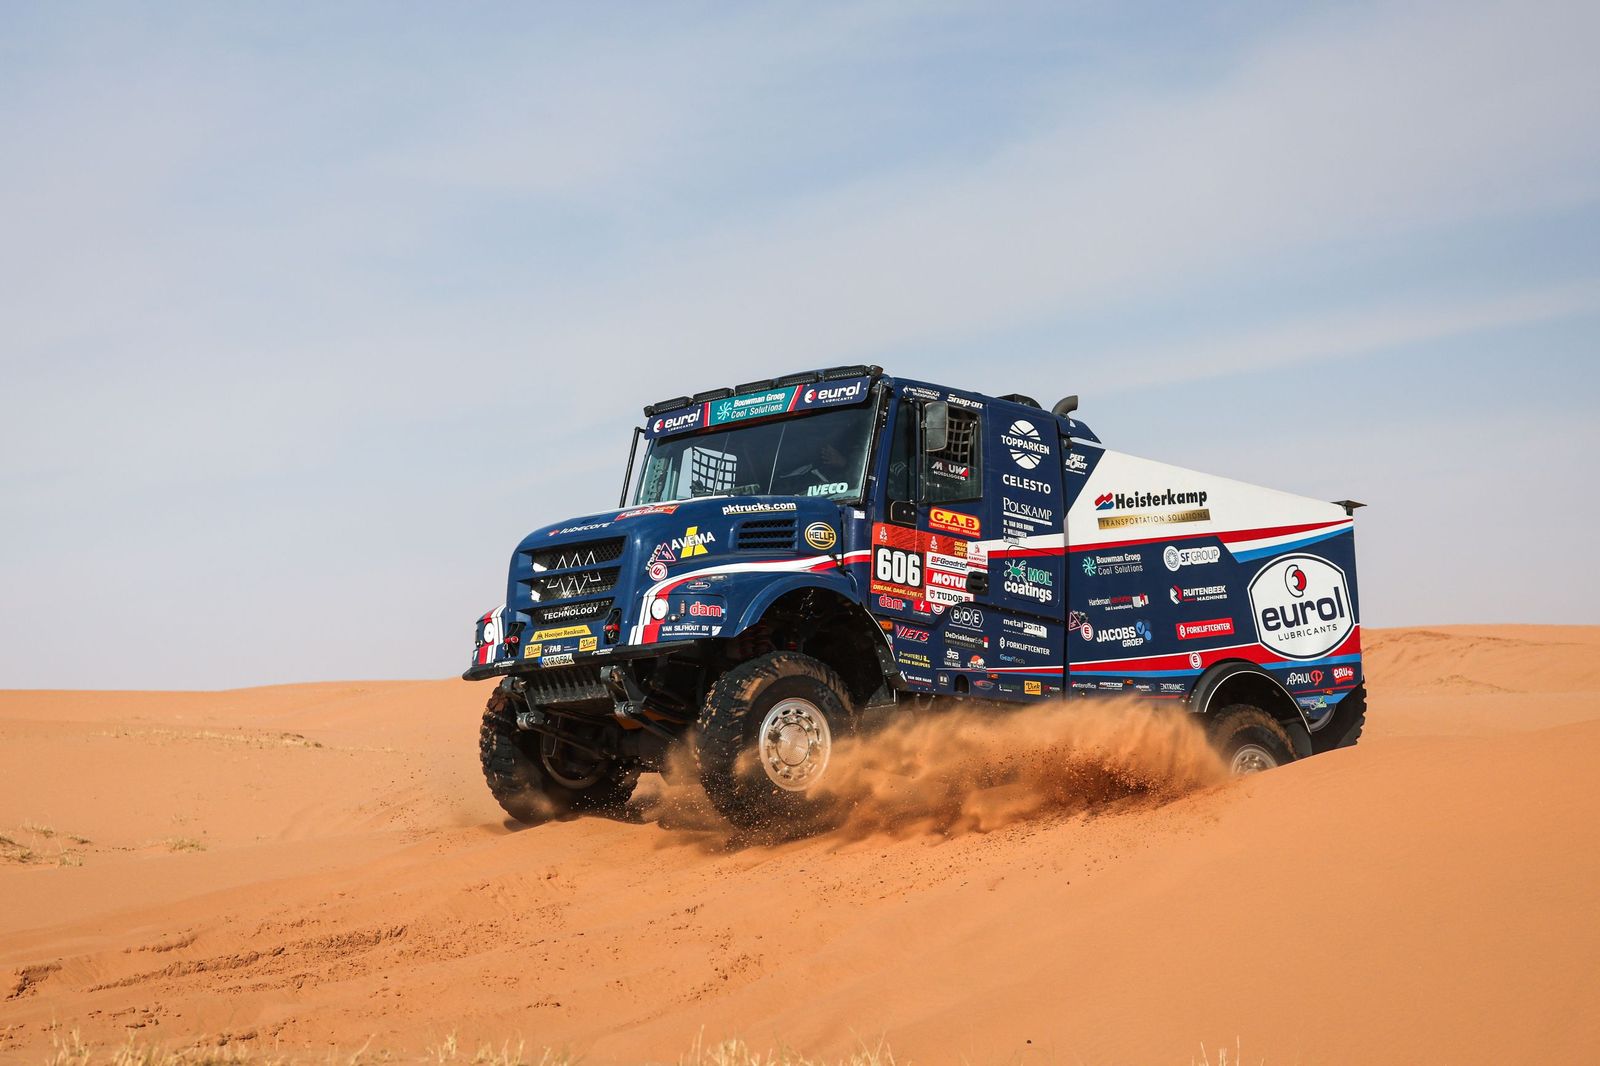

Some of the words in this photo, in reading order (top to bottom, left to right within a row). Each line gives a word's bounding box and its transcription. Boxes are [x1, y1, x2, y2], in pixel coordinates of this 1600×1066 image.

[818, 382, 860, 400] eurol
[734, 395, 765, 408] Bouwman
[766, 392, 786, 402] Groep
[946, 394, 984, 409] Snap-on
[664, 409, 700, 428] eurol
[731, 407, 747, 419] Cool
[750, 403, 783, 416] Solutions
[1001, 435, 1050, 455] TOPPARKEN
[807, 482, 849, 496] IVECO
[1002, 474, 1051, 494] CELESTO
[1115, 489, 1208, 510] Heisterkamp
[722, 502, 796, 515] pktrucks.com
[1003, 497, 1052, 520] POLSKAMP
[934, 512, 975, 528] C.A.B
[1102, 515, 1164, 528] TRANSPORTATION
[1168, 512, 1207, 522] SOLUTIONS
[671, 531, 716, 550] AVEMA
[809, 531, 834, 541] HELLA
[1096, 555, 1124, 563] Bouwman
[1124, 553, 1141, 562] Groep
[1180, 554, 1190, 563] SF
[1191, 550, 1219, 562] GROUP
[877, 548, 920, 587] 606
[1098, 566, 1112, 576] Cool
[1115, 564, 1143, 574] Solutions
[1028, 568, 1052, 586] MOL
[937, 592, 962, 603] TUDOR
[1004, 581, 1052, 602] coatings
[1183, 585, 1226, 597] RUITENBEEK
[690, 601, 722, 617] dam
[879, 594, 903, 611] dam
[1261, 586, 1345, 632] eurol
[544, 606, 598, 620] TECHNOLOGY
[1096, 626, 1136, 643] JACOBS
[1186, 623, 1231, 635] FORKLIFTCENTER
[1278, 624, 1338, 641] LUBRICANTS
[1006, 640, 1050, 656] FORKLIFTCENTER
[1122, 638, 1144, 648] GROEP
